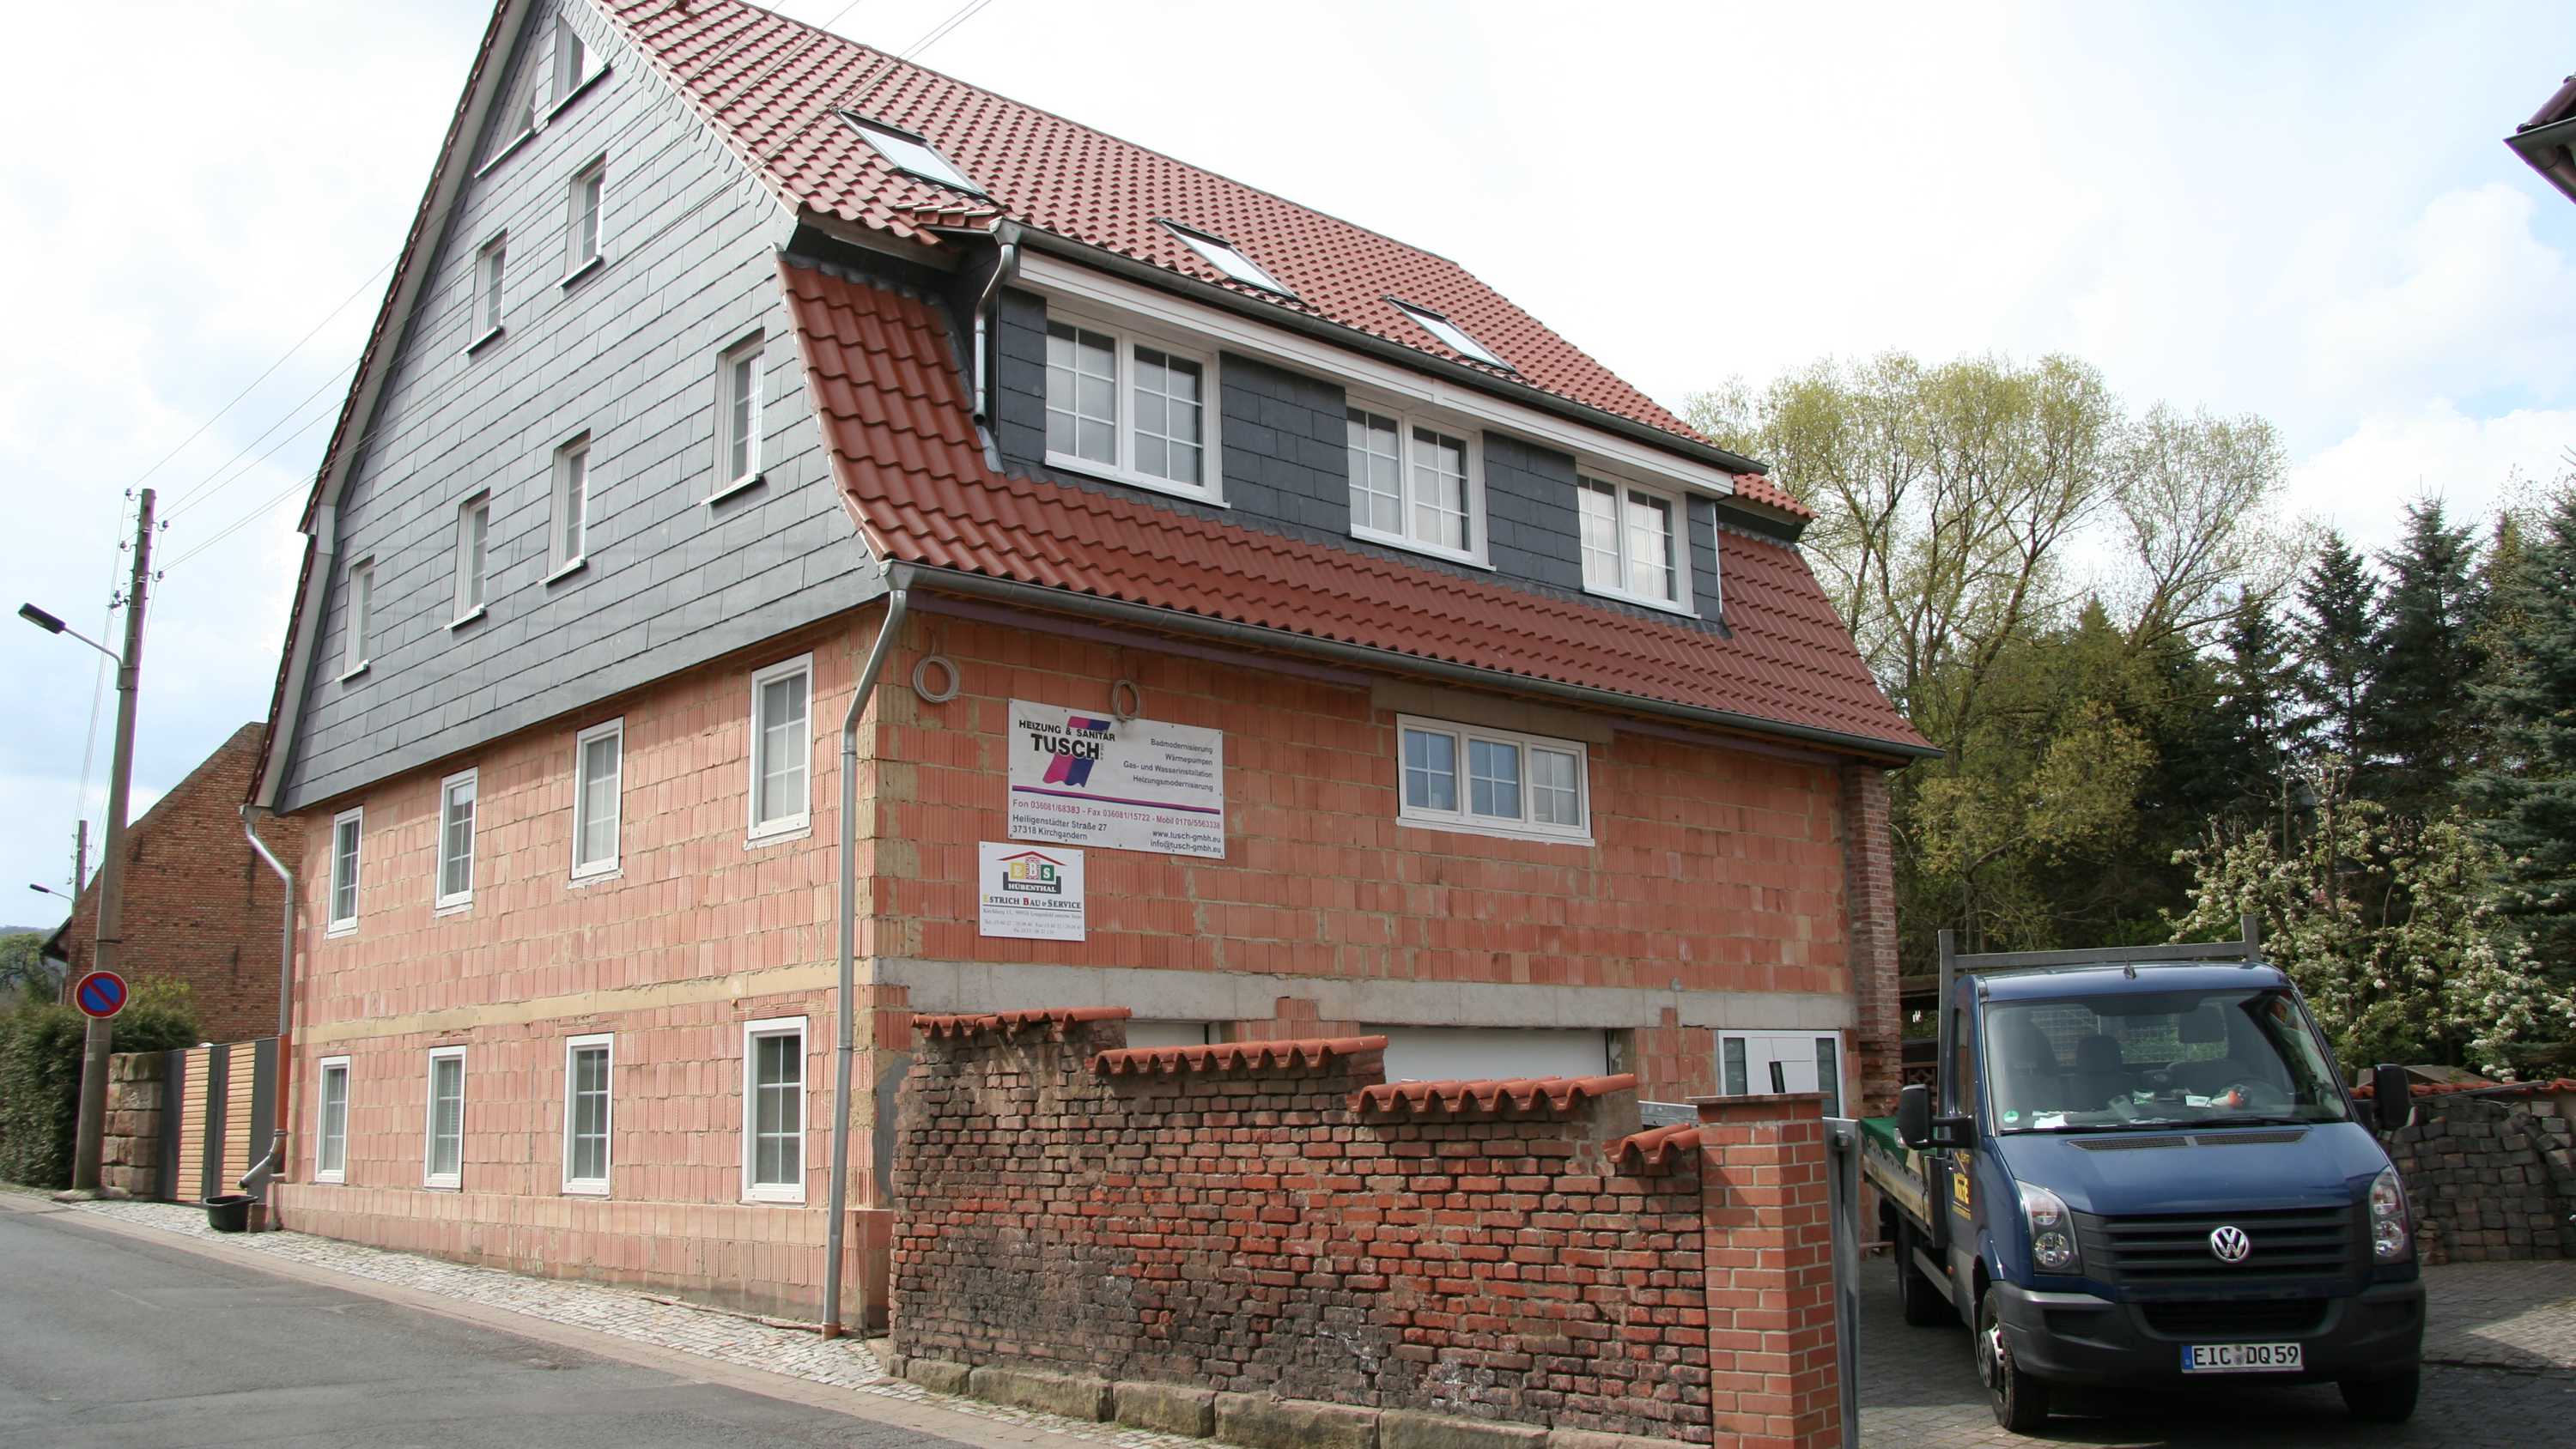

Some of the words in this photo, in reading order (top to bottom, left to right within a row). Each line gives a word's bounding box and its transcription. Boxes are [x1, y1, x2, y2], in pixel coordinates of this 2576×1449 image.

[1018, 719, 1061, 734] HEIZUNG
[1066, 727, 1072, 736] &
[1030, 733, 1099, 761] TUSCH
[1151, 738, 1213, 755] Badmodernisierung
[1165, 754, 1213, 767] Wärmepumpen
[1123, 761, 1139, 769] Gas-
[1155, 765, 1213, 779] Wasserinstallation
[1133, 775, 1214, 792] Heizungsmodernisierung
[1012, 798, 1029, 808] Fon
[1087, 808, 1101, 816] Fax
[1156, 815, 1174, 825] Mobil
[1012, 814, 1069, 828] Heiligenstädter
[1071, 821, 1097, 831] Straße
[1098, 823, 1108, 832] 27
[1012, 825, 1036, 834] 37318
[1038, 828, 1088, 840] Kirchgandern
[1152, 830, 1222, 844] www.tusch-gmbh.eu
[1150, 840, 1222, 853] info@tusch-gmbh.eu
[2193, 1347, 2232, 1366] EIC
[2245, 1345, 2271, 1365] DQ
[2275, 1345, 2300, 1364] 59
